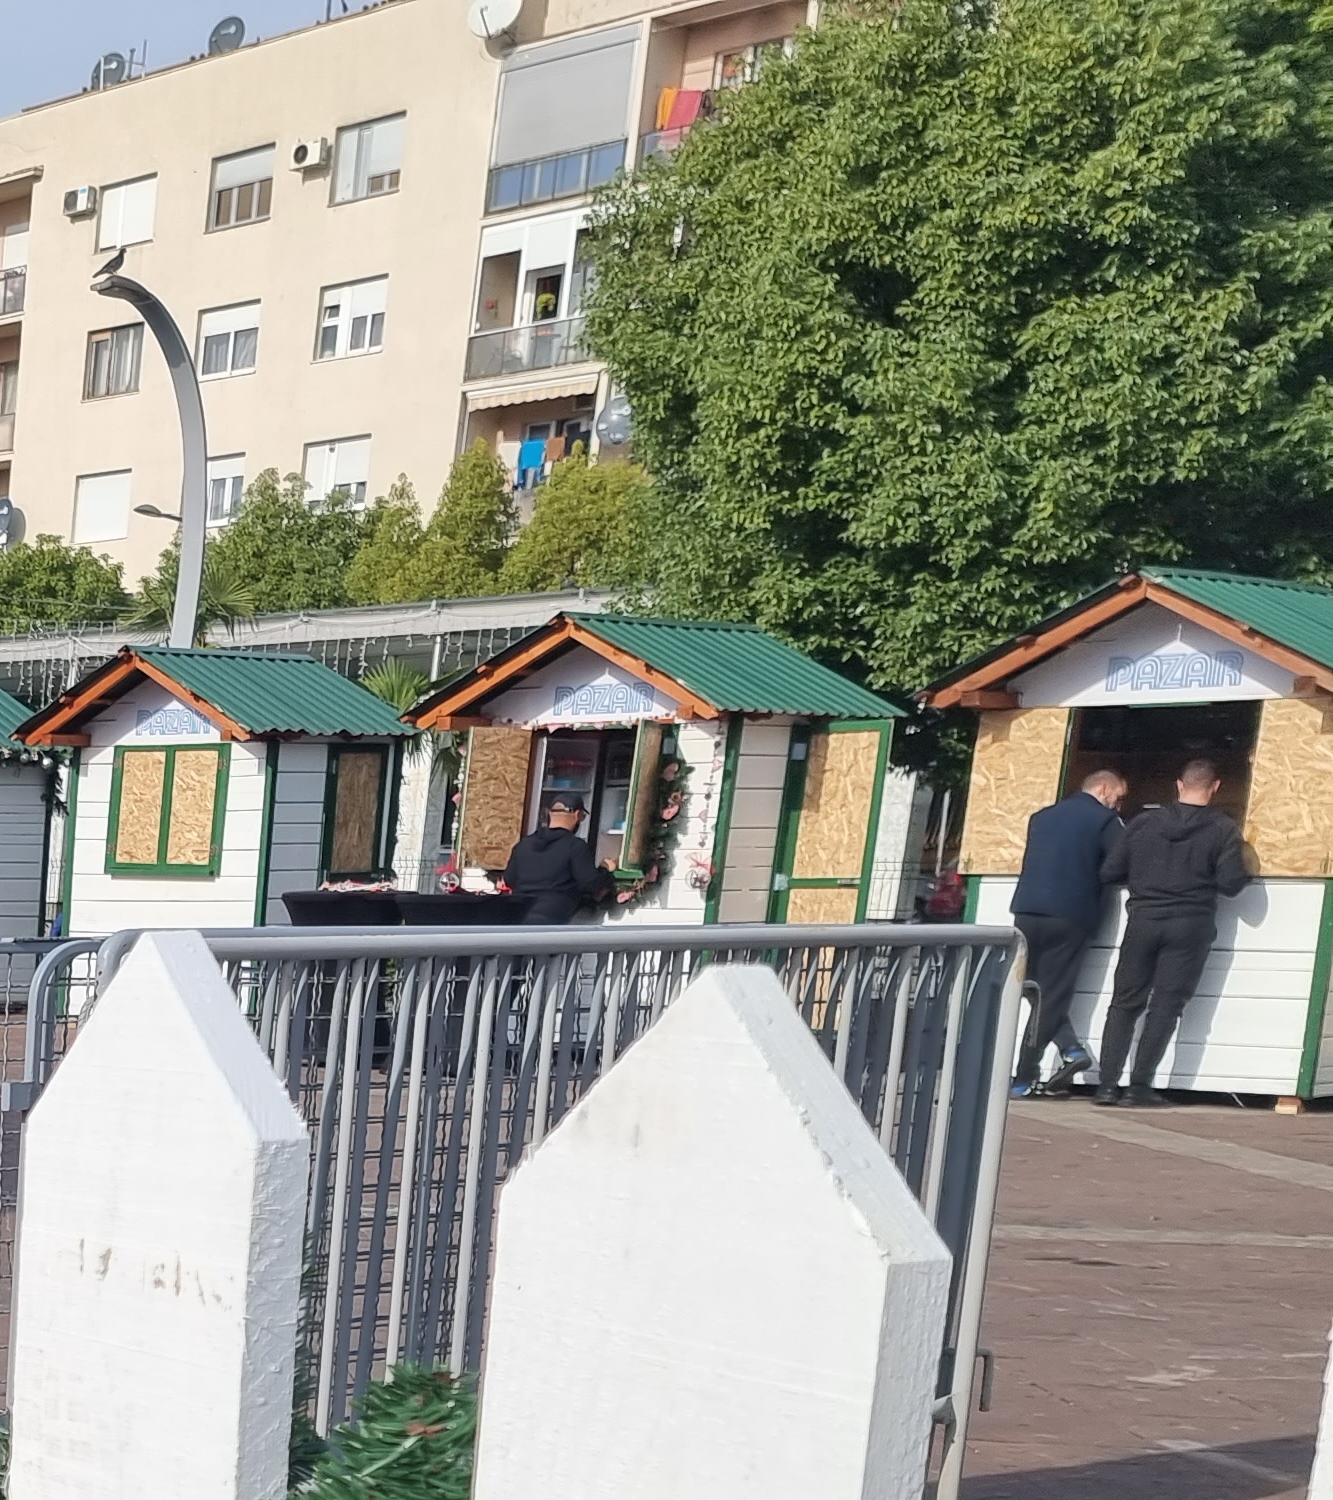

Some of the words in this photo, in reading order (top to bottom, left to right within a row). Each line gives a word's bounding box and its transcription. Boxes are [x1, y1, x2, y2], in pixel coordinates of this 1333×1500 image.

[1105, 651, 1244, 692] PAZAR
[553, 682, 655, 716] PAZAR
[135, 709, 210, 735] PAZAR
